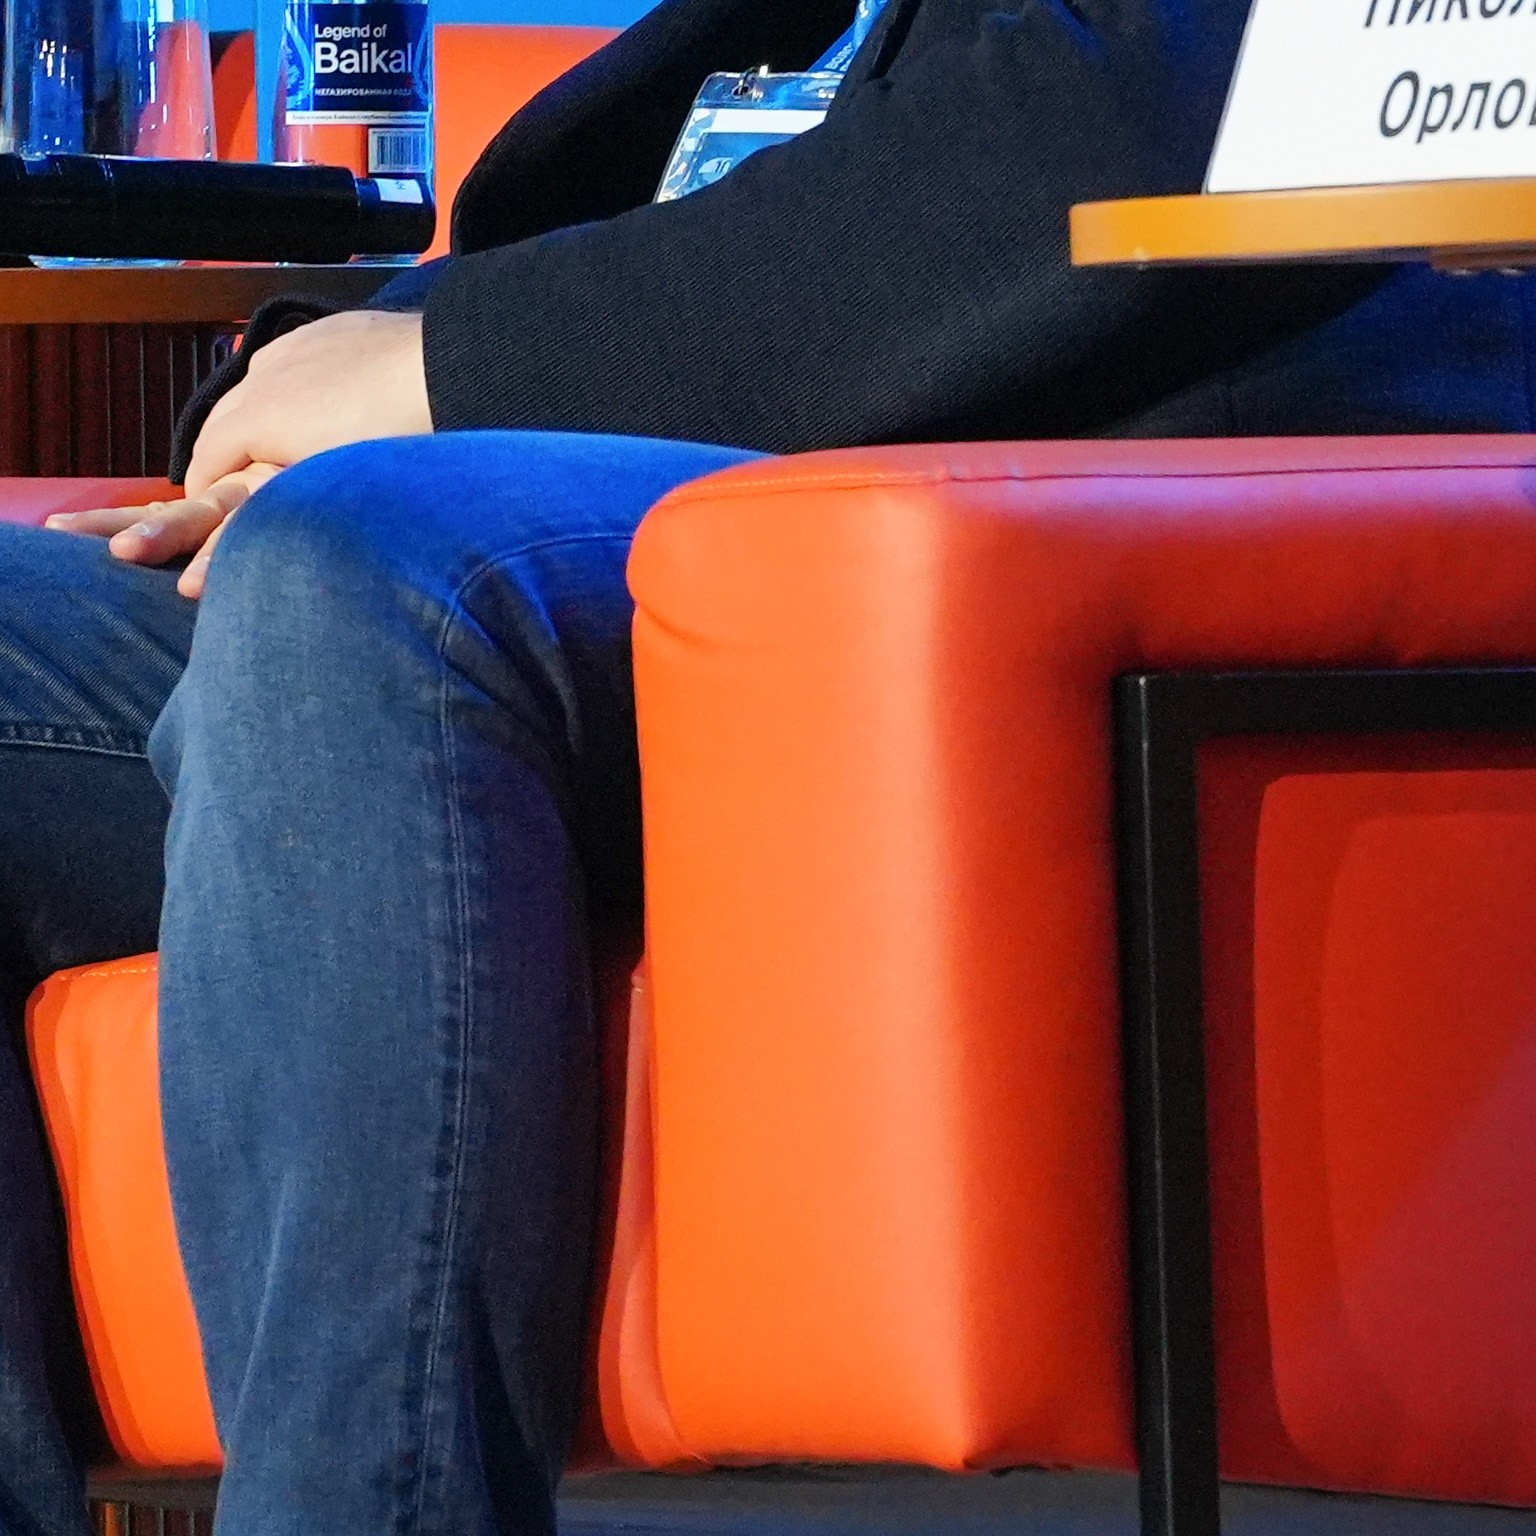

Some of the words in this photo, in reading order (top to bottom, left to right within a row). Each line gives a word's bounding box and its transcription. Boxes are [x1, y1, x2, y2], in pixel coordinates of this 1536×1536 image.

[314, 23, 371, 41] Legend
[373, 23, 388, 38] of
[314, 41, 413, 74] Baikal
